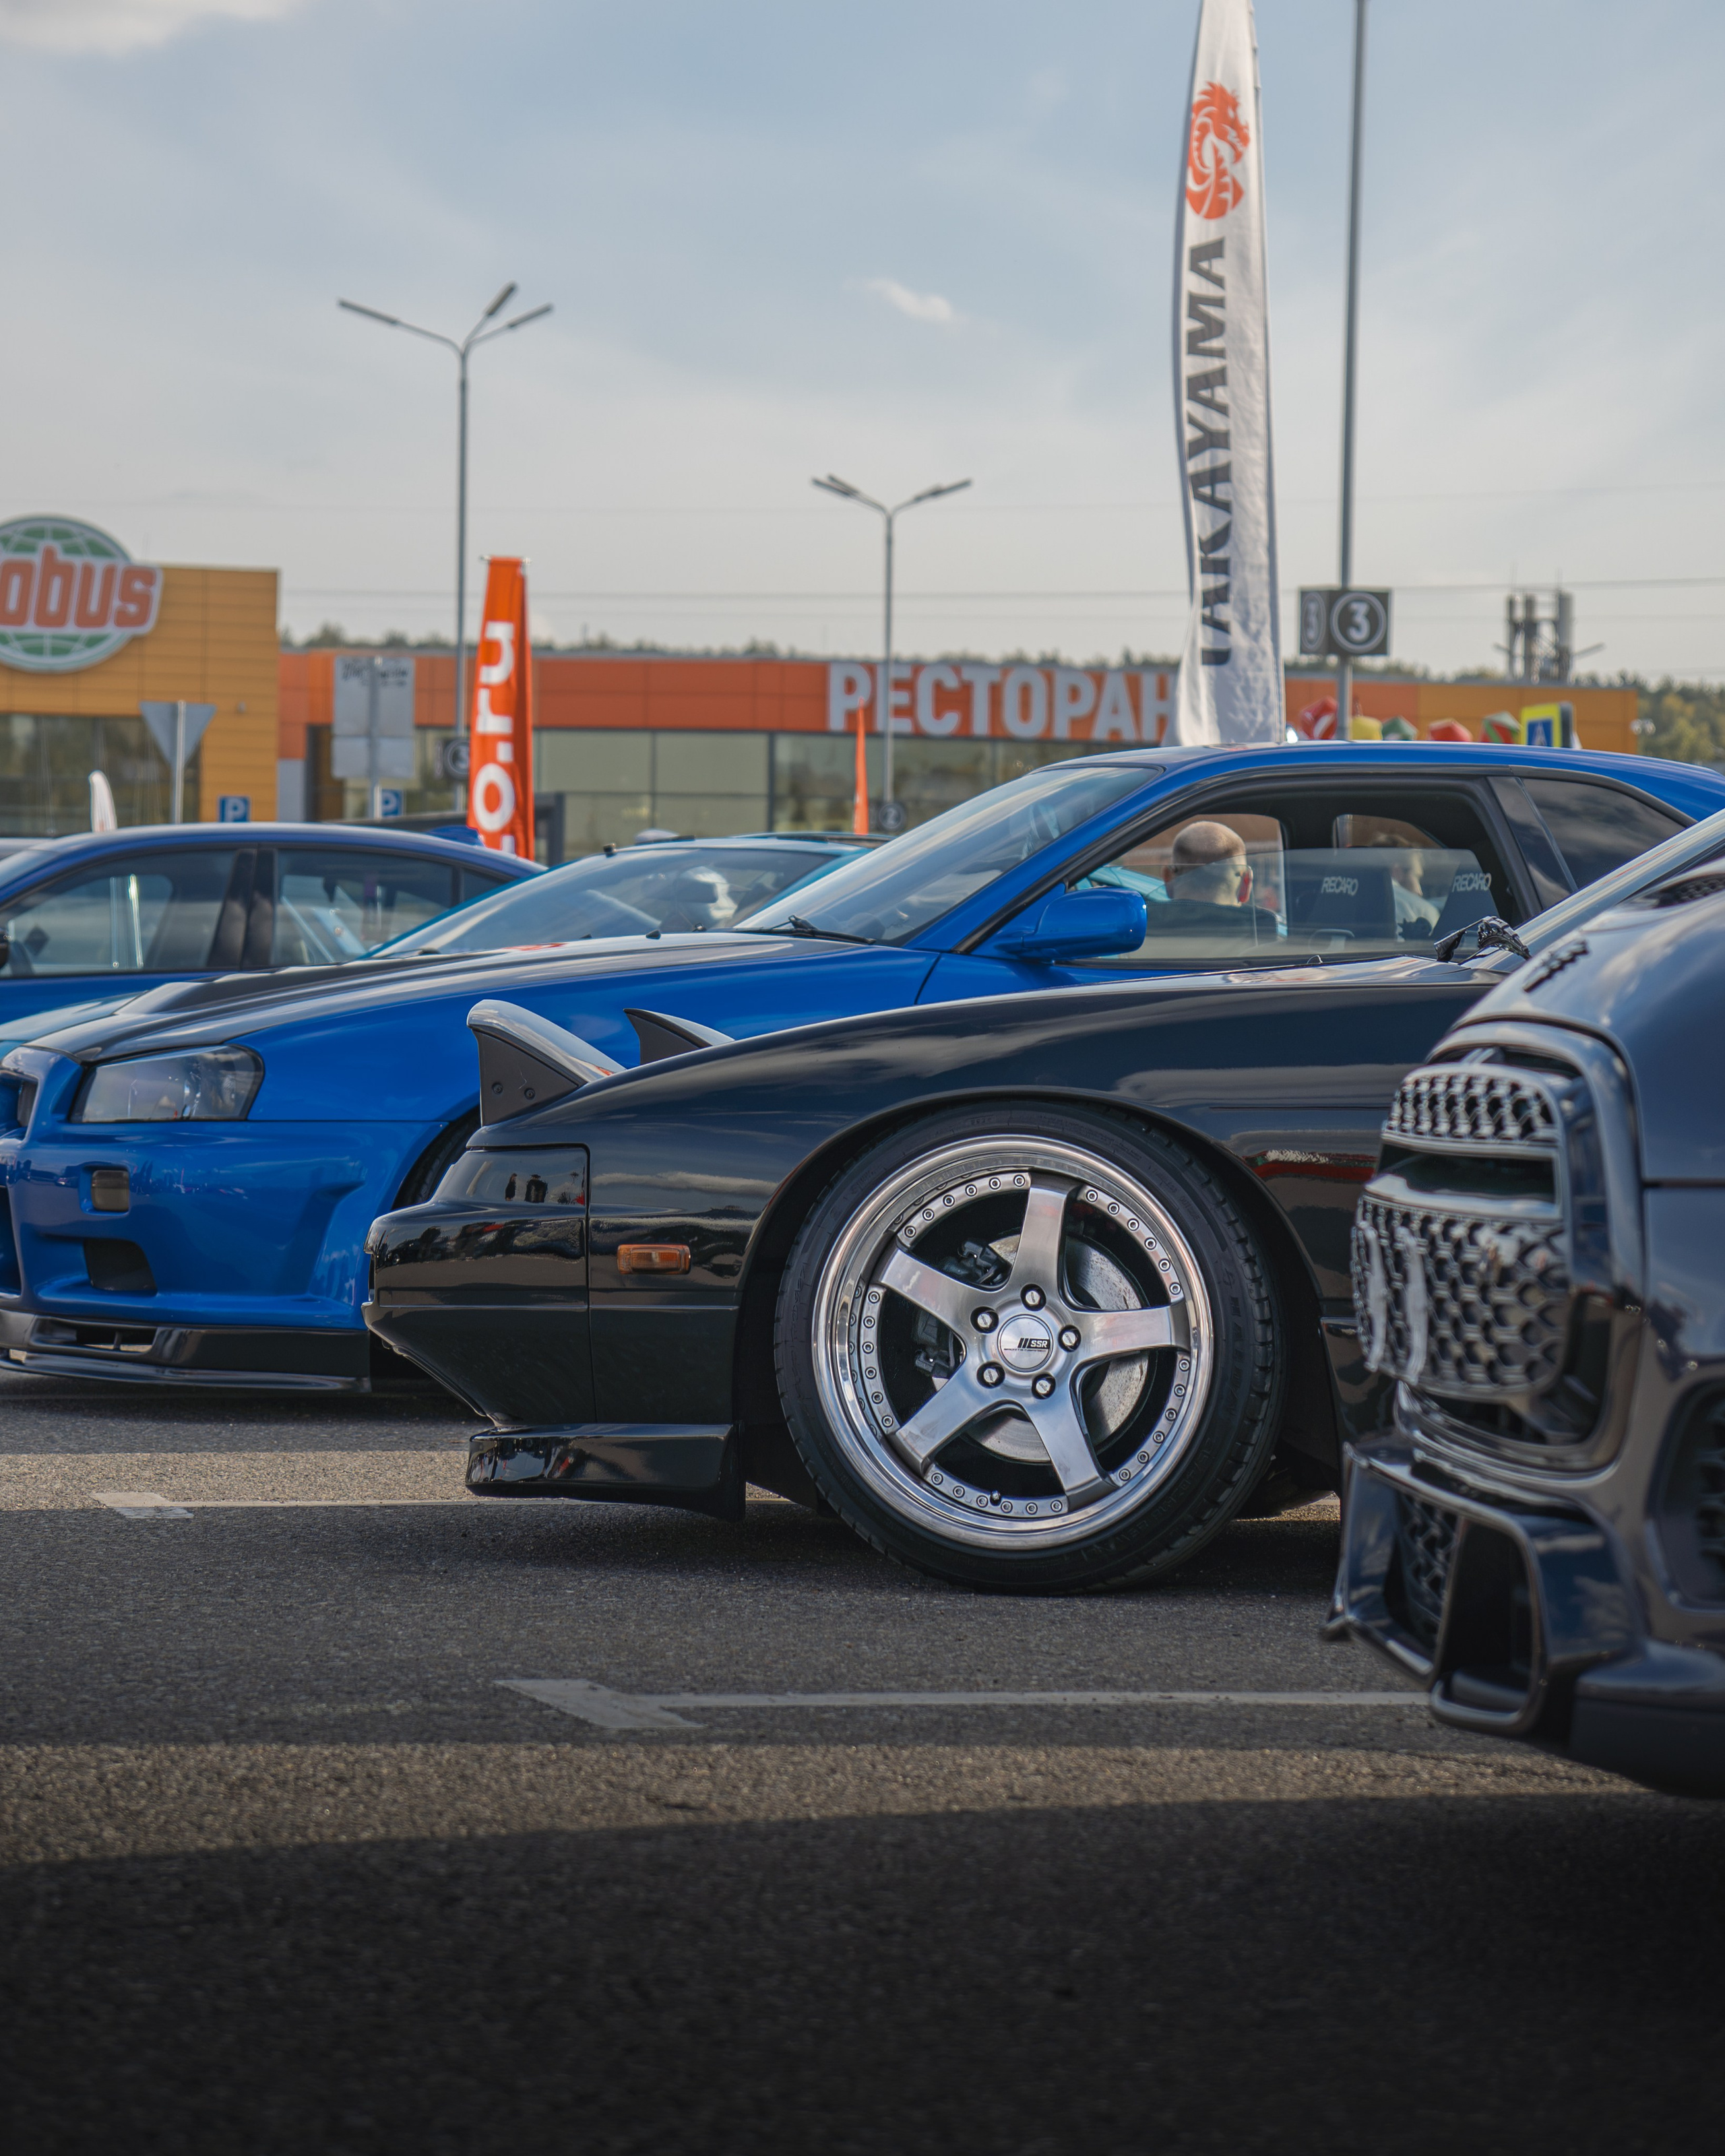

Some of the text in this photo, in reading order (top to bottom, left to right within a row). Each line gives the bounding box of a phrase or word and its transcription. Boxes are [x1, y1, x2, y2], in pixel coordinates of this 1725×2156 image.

[0, 544, 156, 628] obus
[1348, 600, 1370, 642] 3
[828, 662, 1179, 741] РЕСТОРАН
[1321, 876, 1358, 897] RECARO
[1452, 873, 1492, 893] RECARO
[1030, 1339, 1048, 1348] SSR
